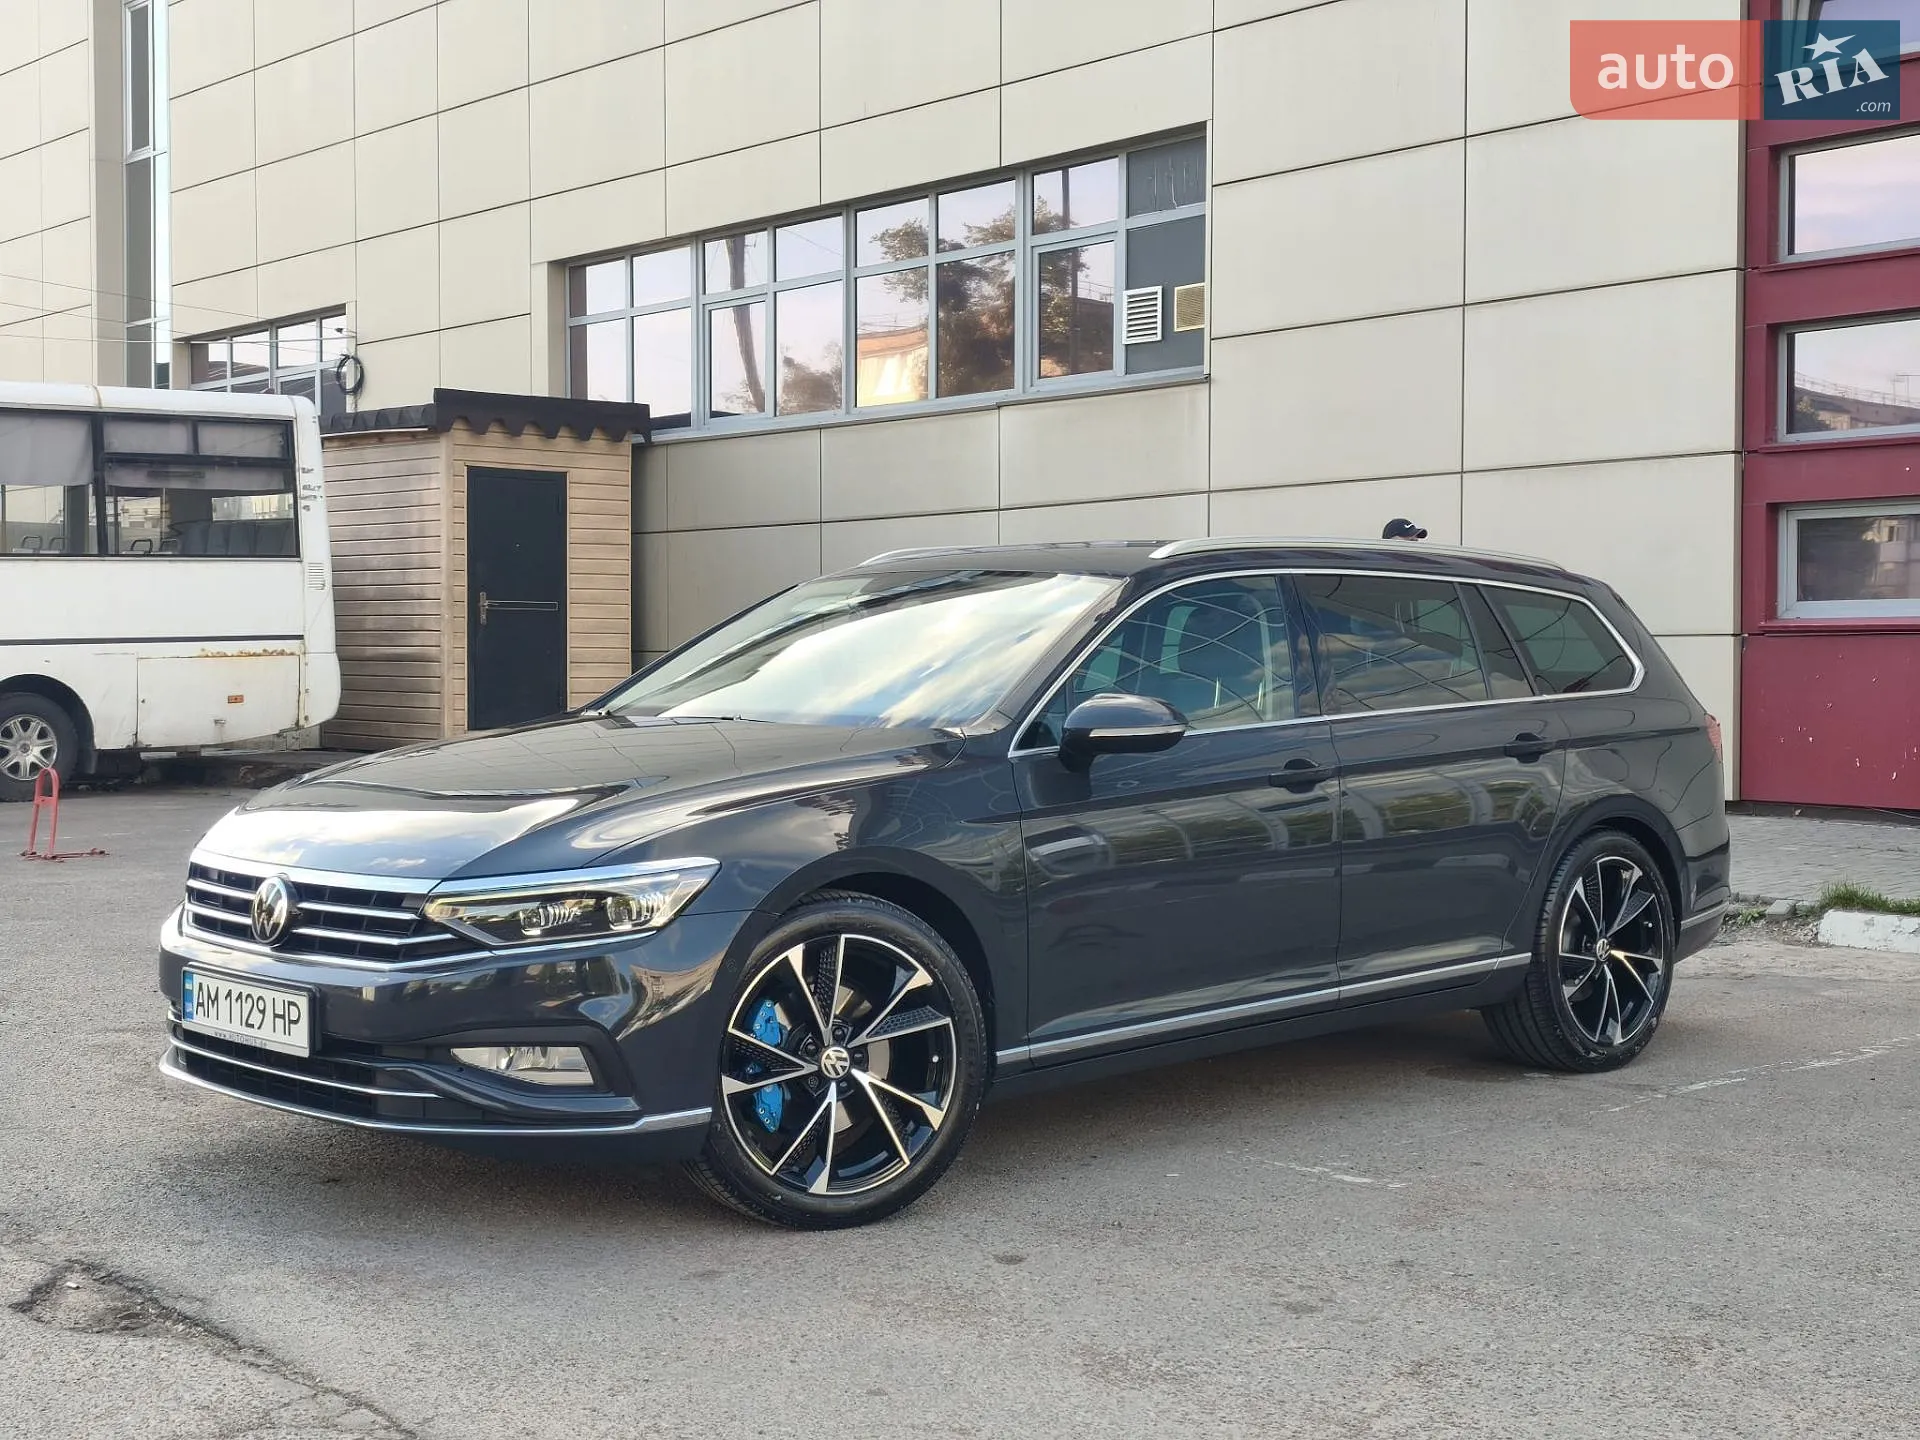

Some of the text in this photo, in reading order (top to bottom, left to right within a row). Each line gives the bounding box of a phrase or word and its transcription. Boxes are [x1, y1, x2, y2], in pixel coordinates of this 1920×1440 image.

[196, 983, 301, 1036] AM 1129 HP
